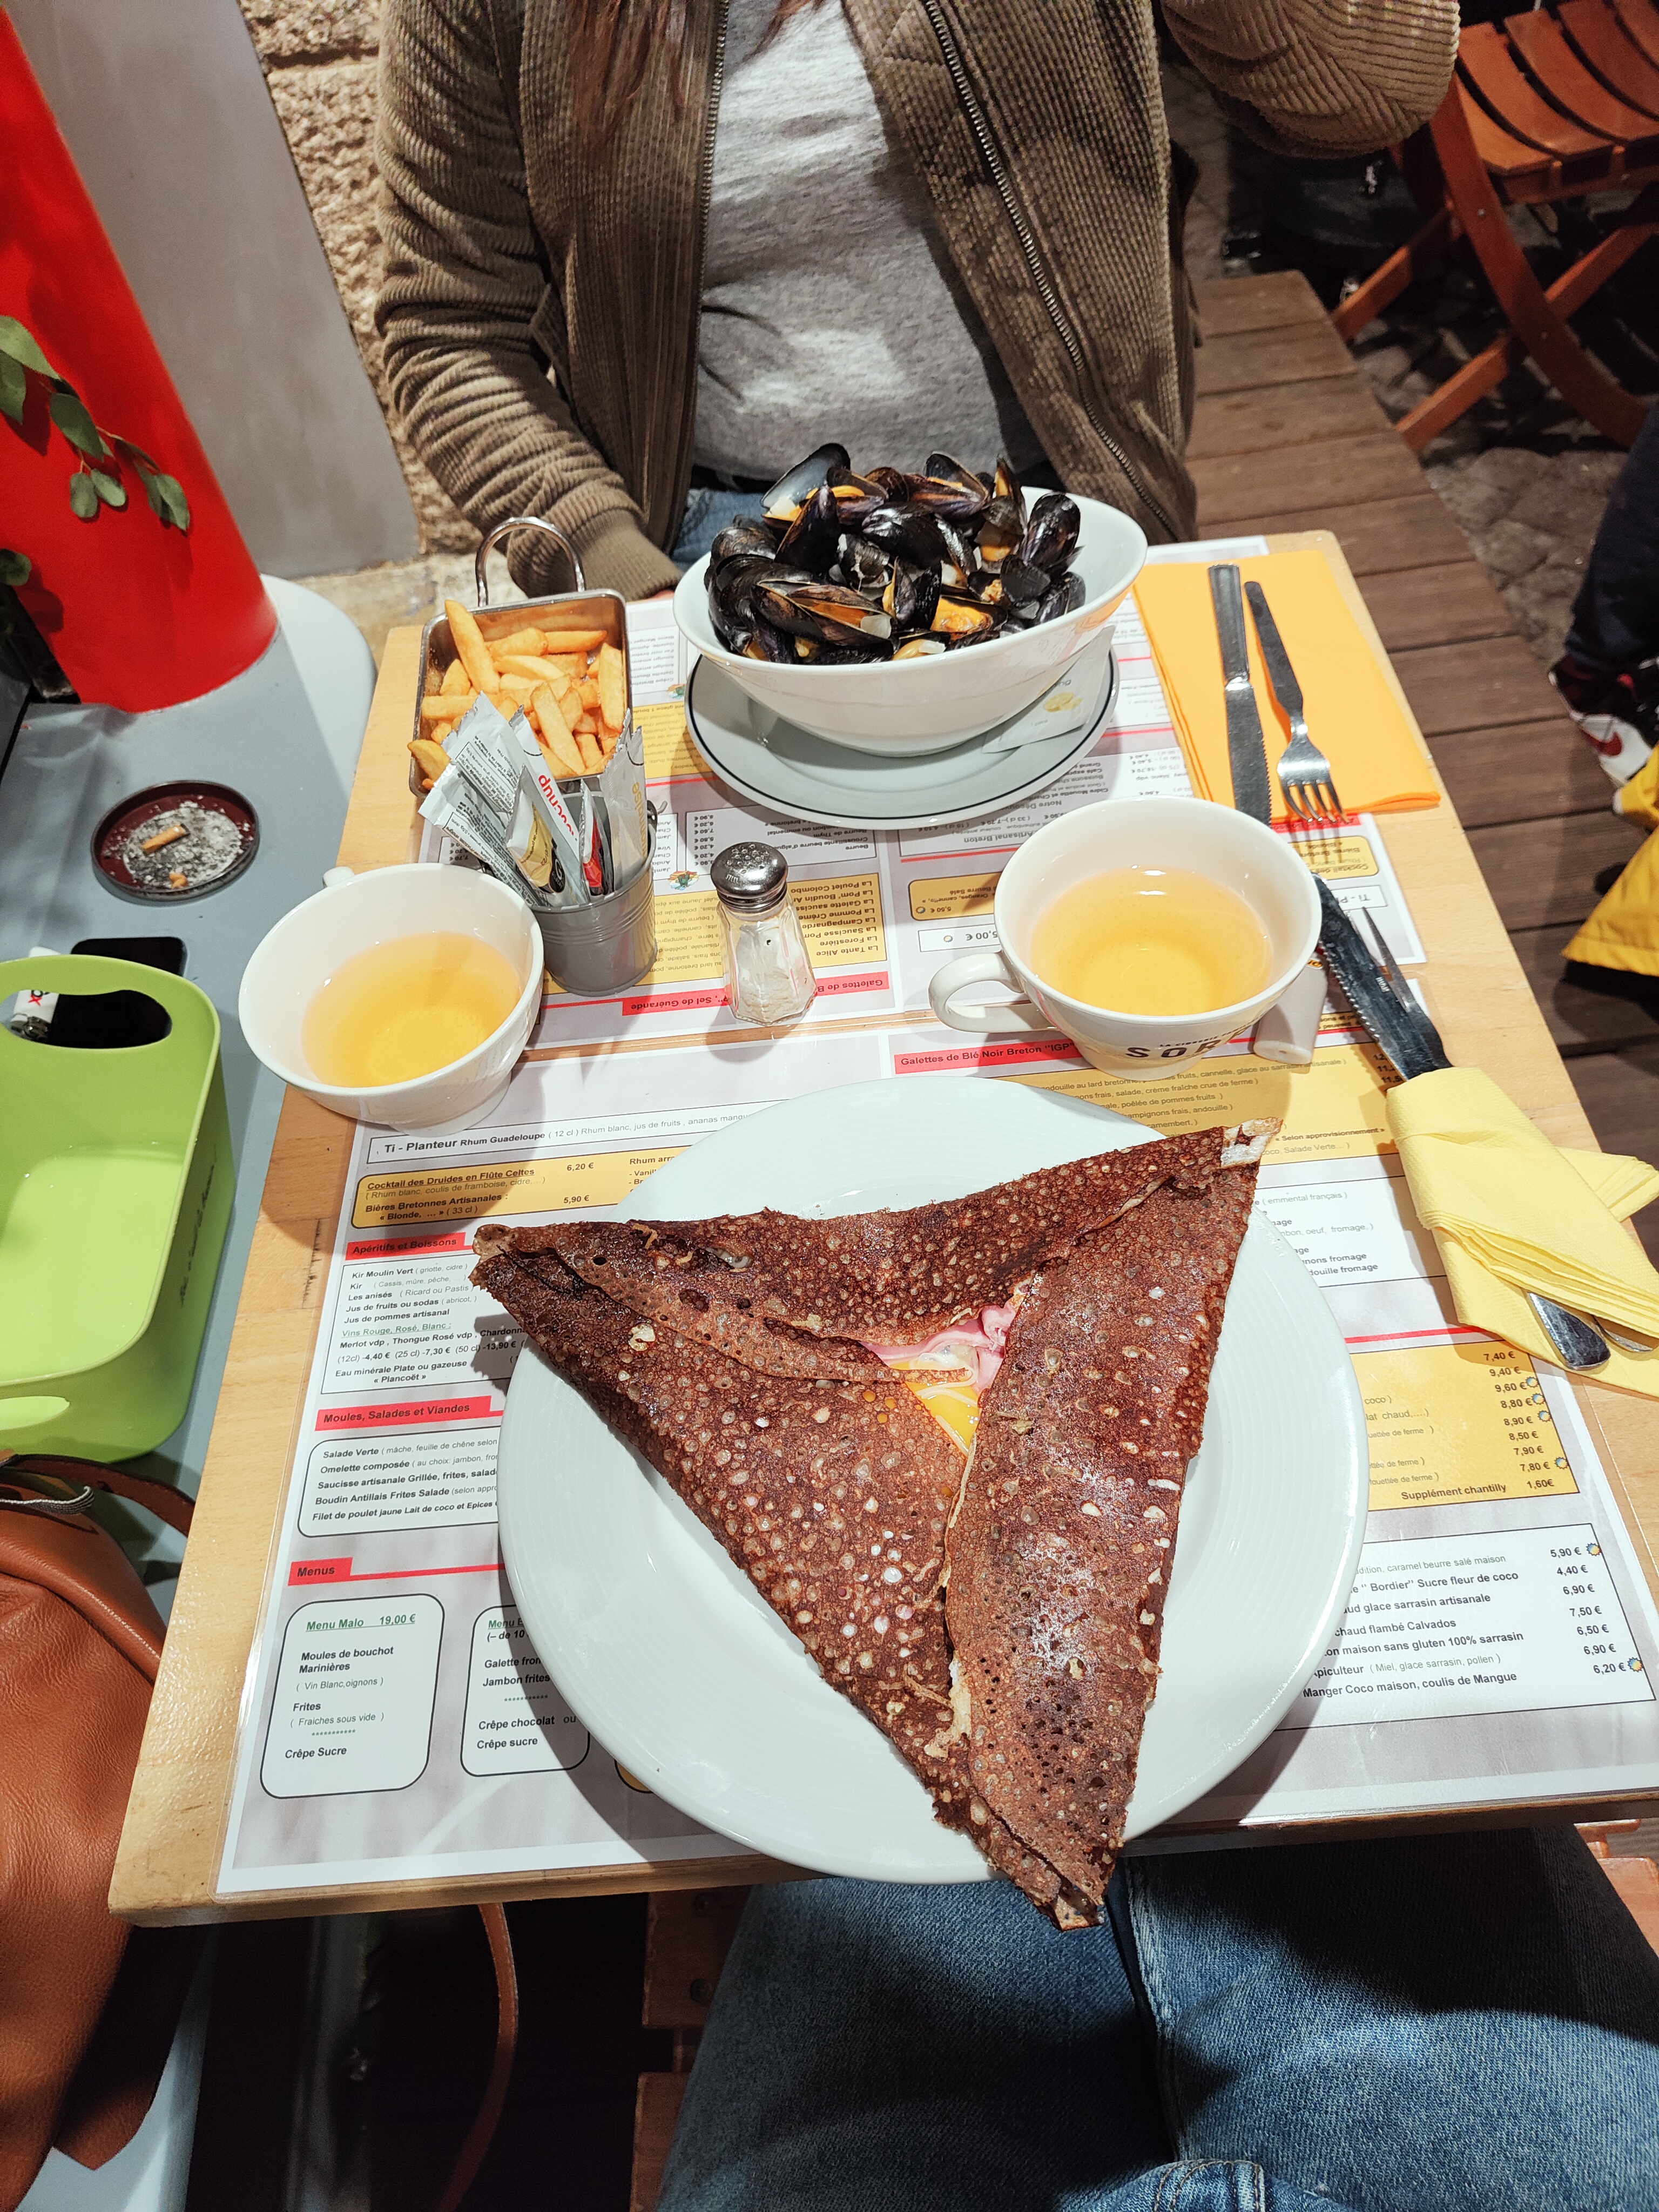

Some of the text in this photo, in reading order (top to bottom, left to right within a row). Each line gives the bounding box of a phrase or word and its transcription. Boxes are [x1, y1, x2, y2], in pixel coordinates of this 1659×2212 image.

[790, 885, 831, 894] Colombo
[831, 882, 860, 891] Poulet
[975, 928, 999, 940] 5,00
[630, 1000, 679, 1011] Guérande
[696, 997, 712, 1005] Sel
[901, 1054, 945, 1065] Galettes
[961, 1051, 979, 1060] Blé
[981, 1049, 1004, 1058] Noir
[1006, 1047, 1042, 1055] Breton
[1160, 1096, 1195, 1105] pommes
[1195, 1093, 1216, 1101] fruits
[384, 1143, 396, 1153] Ti
[406, 1139, 458, 1151] Planteur
[460, 1138, 488, 1147] Rhum
[489, 1133, 545, 1143] Guadeloupe
[633, 1123, 646, 1131] jus
[687, 1117, 718, 1125] ananas
[1305, 1127, 1380, 1140] approvisionnement
[566, 1163, 586, 1172] 6,20
[367, 1179, 406, 1189] Cocktail
[426, 1175, 463, 1184] Druides
[479, 1171, 504, 1180] Flûte
[505, 1169, 535, 1178] Celtes
[365, 1193, 502, 1213] Bières Bretonnes Artisanales
[563, 1195, 582, 1205] 5,90
[352, 1238, 456, 1255] Apéritifs et Boissons
[366, 1269, 394, 1278] Moulin
[373, 1312, 411, 1323] pommes
[412, 1307, 450, 1318] artisanal
[395, 1324, 419, 1332] Rosé,
[421, 1323, 446, 1331] Blanc
[339, 1327, 524, 1348] Merlot vdp Thongue Rosé vdp Chardonn
[353, 1366, 392, 1375] minérale
[393, 1364, 415, 1372] Plate
[430, 1360, 467, 1371] gazeuse
[1488, 1367, 1512, 1378] 9,40
[380, 1373, 420, 1383] Plancoët
[323, 1404, 470, 1423] Moules, Salades et Viandes
[322, 1449, 354, 1459] Salade
[355, 1447, 379, 1456] Verte
[386, 1445, 414, 1454] mâche,
[415, 1443, 439, 1451] feuille
[451, 1440, 475, 1448] chêne
[476, 1438, 497, 1447] selon
[1512, 1446, 1535, 1456] 7,90
[317, 1479, 359, 1489] Saucisse
[360, 1475, 406, 1486] artisanale
[407, 1472, 440, 1482] Grillée,
[442, 1471, 469, 1480] frites,
[1526, 1478, 1555, 1490] 1,60€
[314, 1487, 450, 1505] Boudin Antillais Frites Salade
[1400, 1482, 1506, 1501] Supplément chantilly
[1549, 1547, 1572, 1559] 5,90
[296, 1566, 335, 1577] Menus
[1556, 1565, 1579, 1576] 4,40
[1417, 1578, 1448, 1588] Sucre
[1449, 1575, 1474, 1585] fleur
[1476, 1573, 1490, 1583] de
[1492, 1572, 1519, 1581] coco
[306, 1620, 336, 1630] Menu
[338, 1617, 364, 1628] Malo
[379, 1614, 407, 1625] 19,00
[1368, 1621, 1405, 1634] flambé
[1406, 1618, 1456, 1630] Calvados
[1341, 1631, 1524, 1655] maison sans gluten 100% sarrasin
[300, 1645, 394, 1661] Moules de bouchot
[298, 1662, 350, 1674] Marinières
[1374, 1662, 1397, 1672] Miel,
[1398, 1661, 1424, 1672] glace
[1425, 1657, 1465, 1668] sarrasin,
[1466, 1655, 1494, 1667] pollen
[1593, 1663, 1616, 1675] 6,20
[304, 1678, 378, 1690] Vin Blanc,oignons
[482, 1673, 551, 1687] Jambon frites
[1303, 1673, 1517, 1698] Manger Coco maison, coulis de Mangue
[292, 1702, 321, 1712] Frites
[336, 1715, 356, 1724] sous
[358, 1712, 376, 1722] vide
[478, 1715, 577, 1731] Crêpe chocolat ou
[476, 1737, 538, 1750] Crêpe sucre
[285, 1746, 347, 1760] Crêpe Sucre
